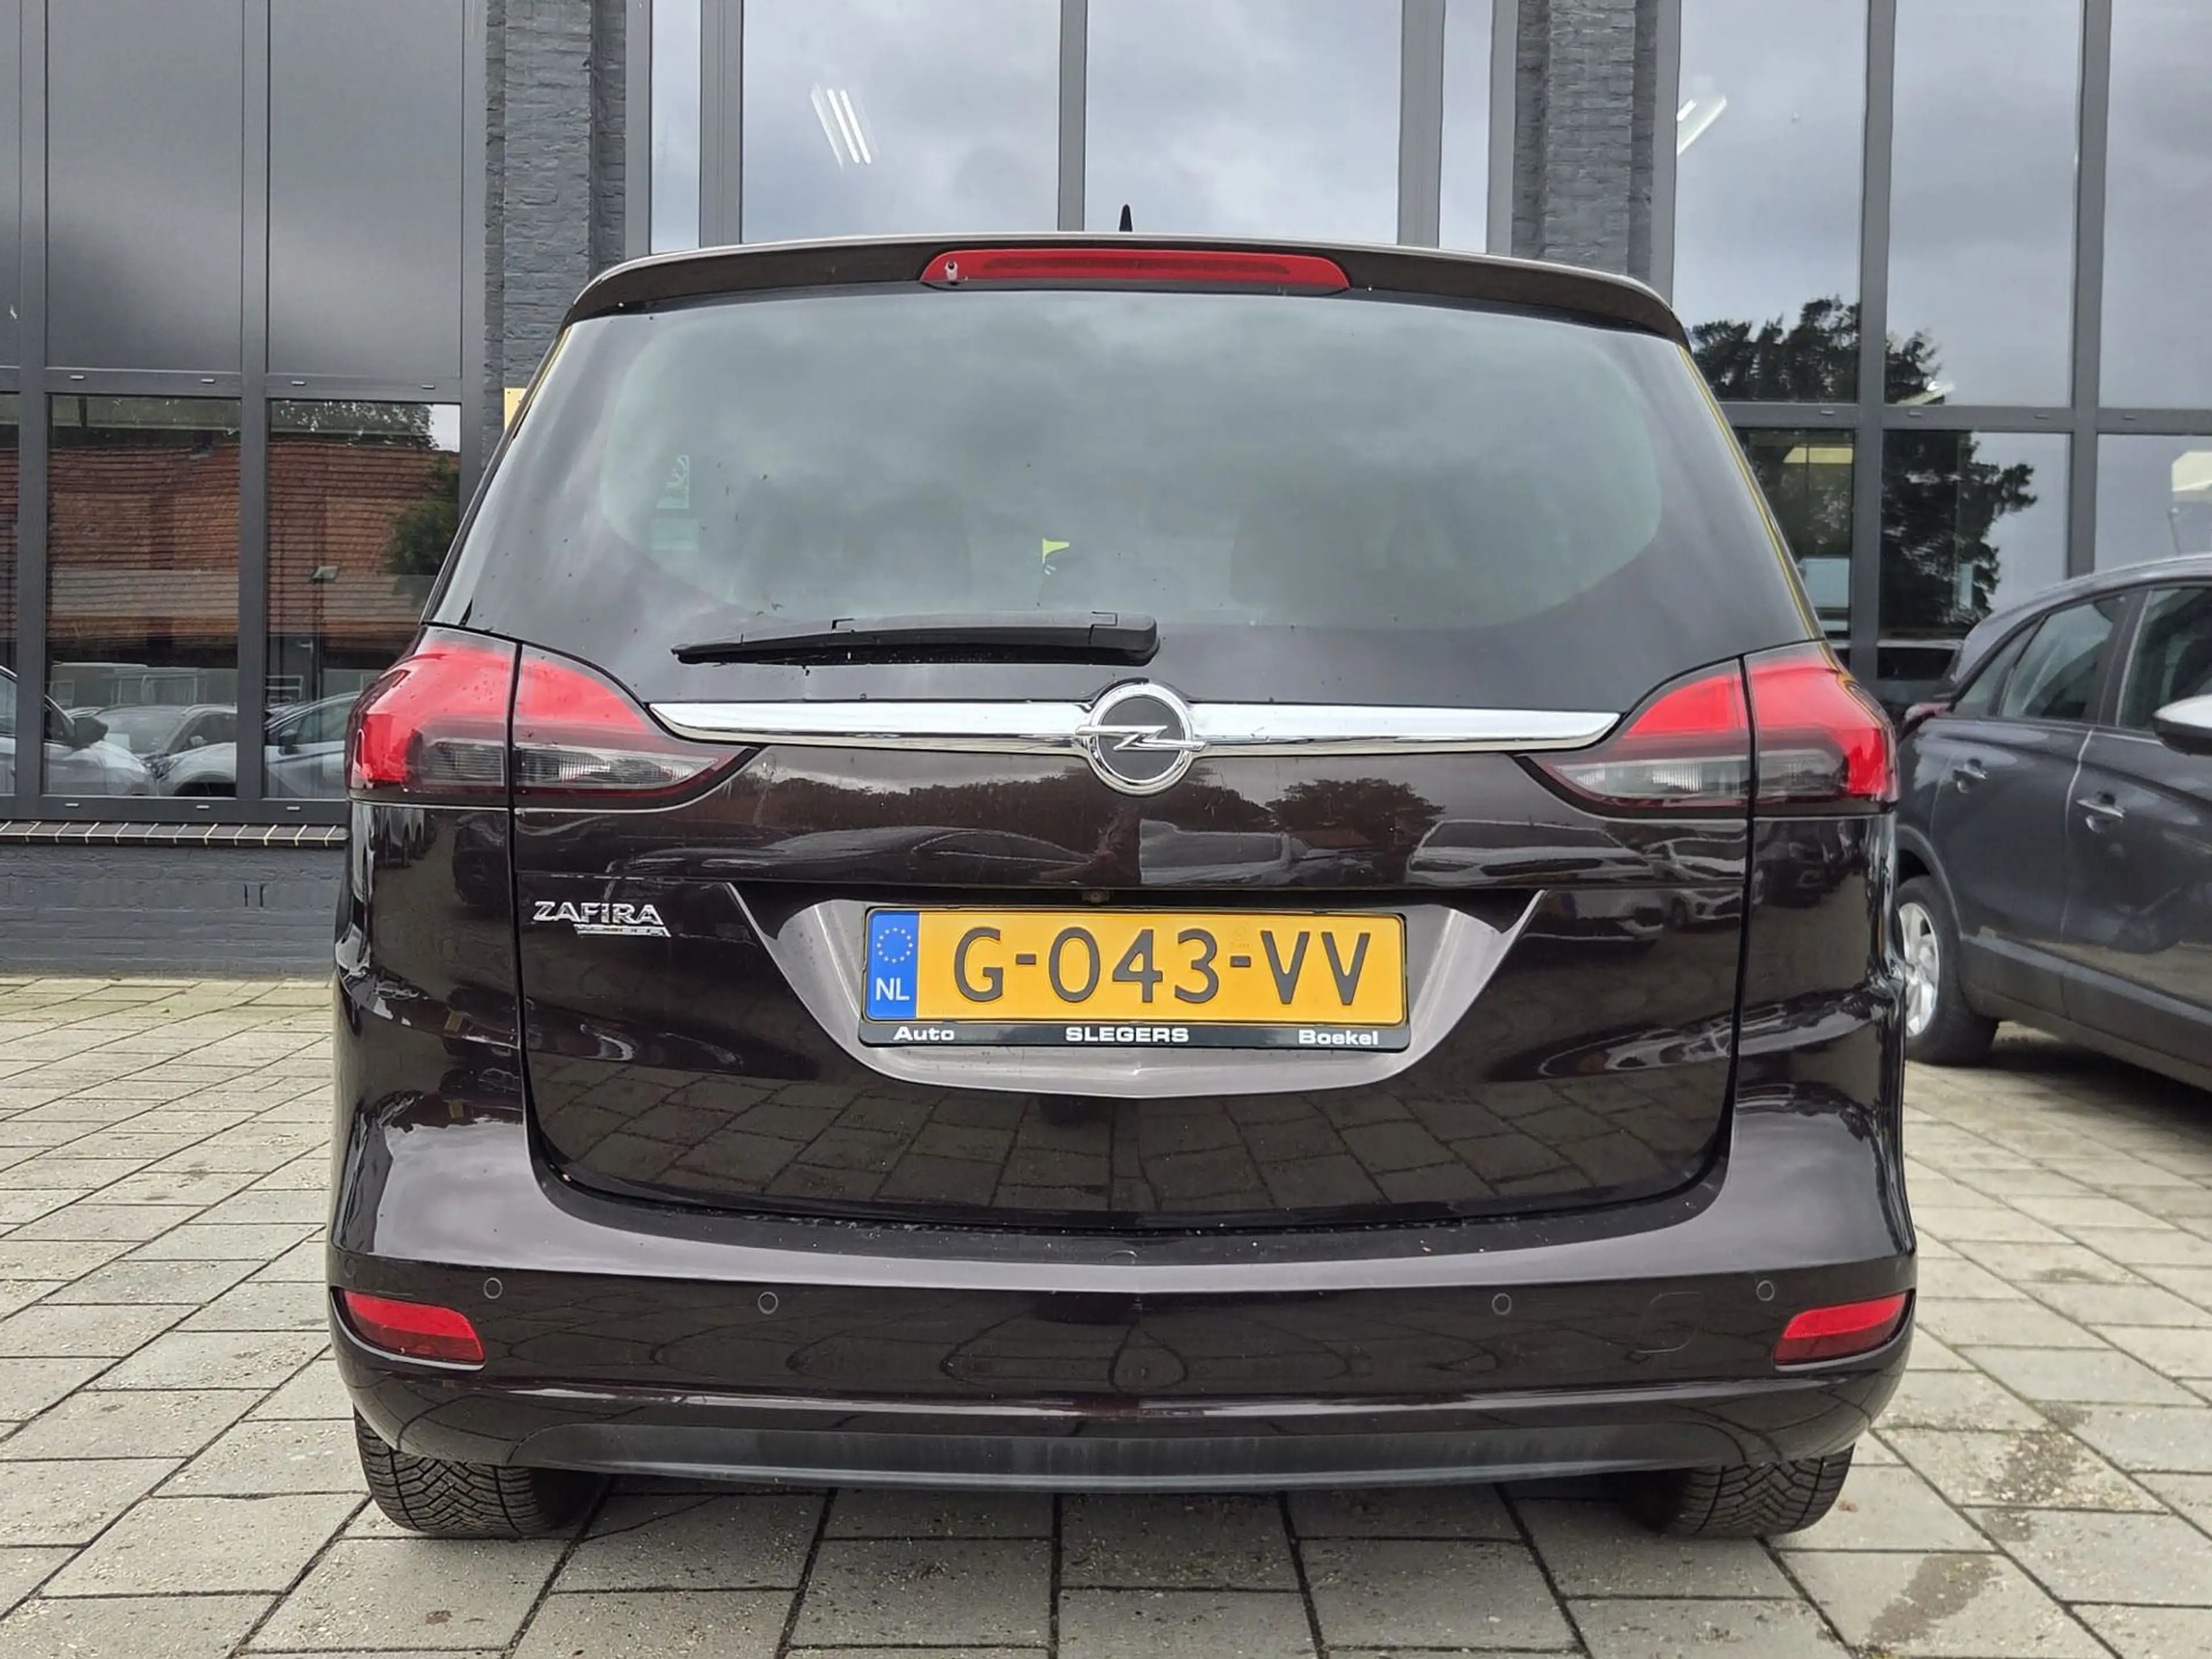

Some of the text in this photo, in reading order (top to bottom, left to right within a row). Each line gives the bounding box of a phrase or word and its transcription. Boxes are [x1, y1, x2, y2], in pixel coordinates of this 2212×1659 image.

[532, 900, 664, 925] ZAFIRA
[953, 926, 1370, 1006] G-043-VV
[875, 977, 910, 1001] NL
[893, 1026, 1379, 1046] Auto SLEGERS Boekel
